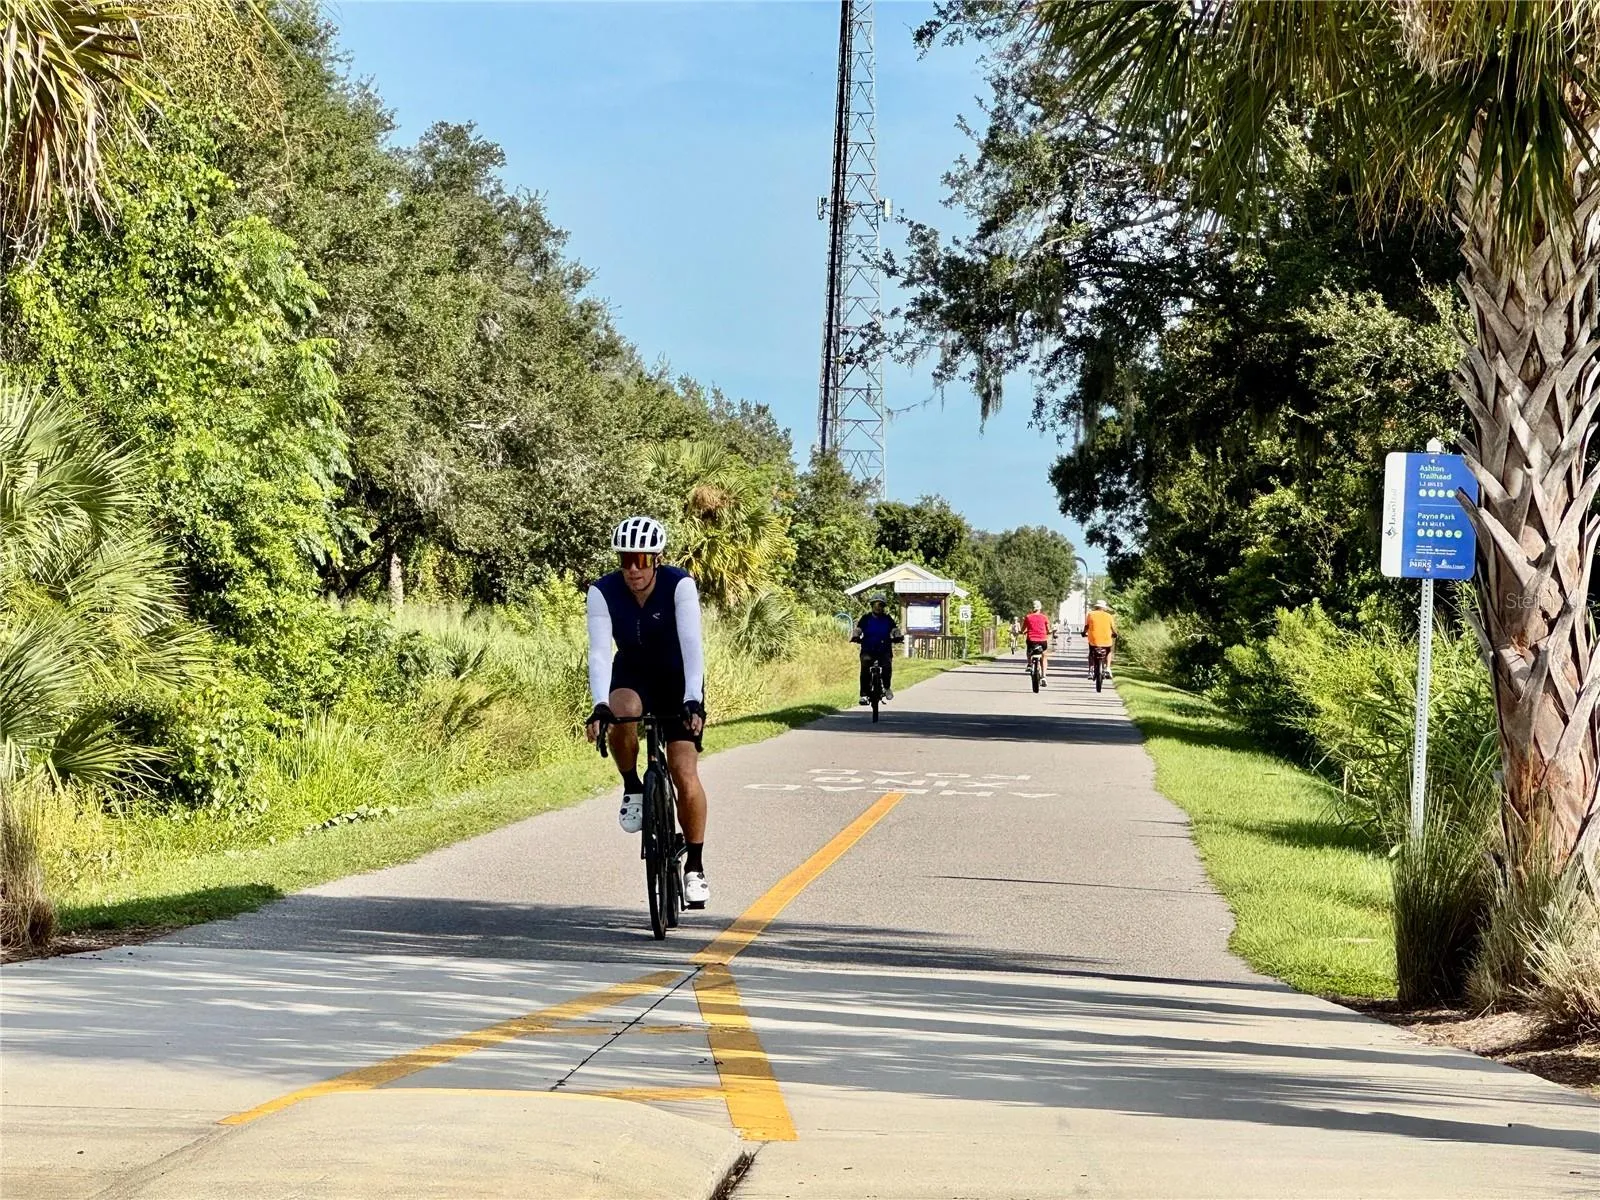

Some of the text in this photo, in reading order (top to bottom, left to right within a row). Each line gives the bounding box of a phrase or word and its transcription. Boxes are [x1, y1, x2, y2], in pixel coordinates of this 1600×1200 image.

[1419, 465, 1445, 473] Ashton
[1417, 512, 1439, 521] Payne
[806, 768, 1032, 781] ROAD
[811, 776, 1009, 788] XING
[743, 783, 1057, 798] AHEAD
